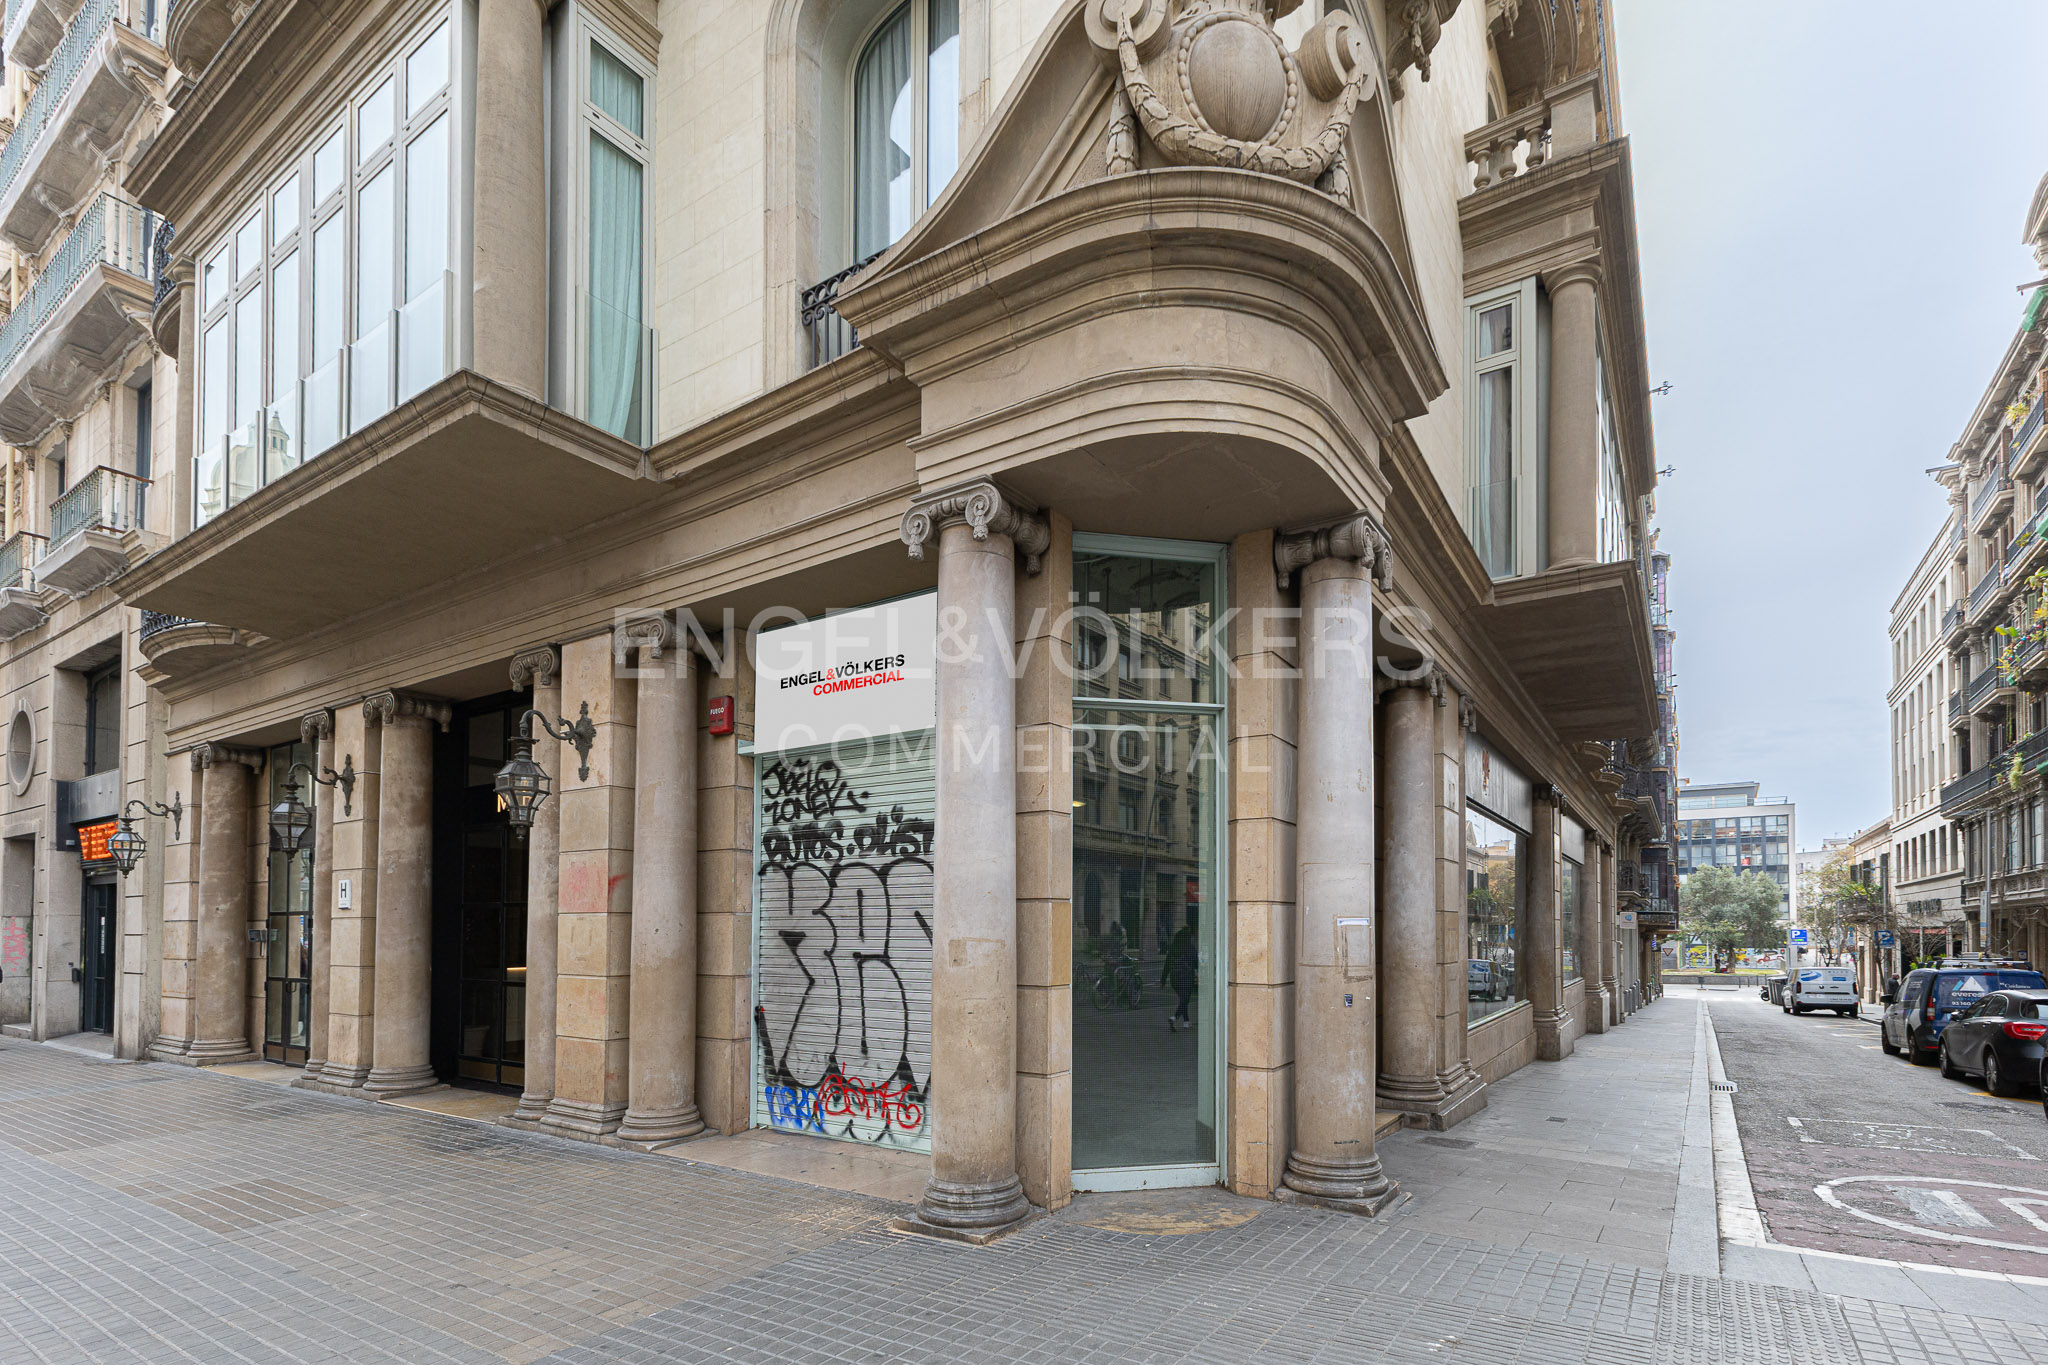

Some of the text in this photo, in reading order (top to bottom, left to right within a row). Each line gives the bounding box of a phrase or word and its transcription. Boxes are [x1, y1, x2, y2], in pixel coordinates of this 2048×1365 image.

[780, 654, 905, 690] ENGEL&VÖLKERS
[813, 669, 905, 697] COMMERCIAL
[710, 707, 725, 715] FUEGO
[340, 882, 347, 899] H
[1791, 930, 1801, 939] P
